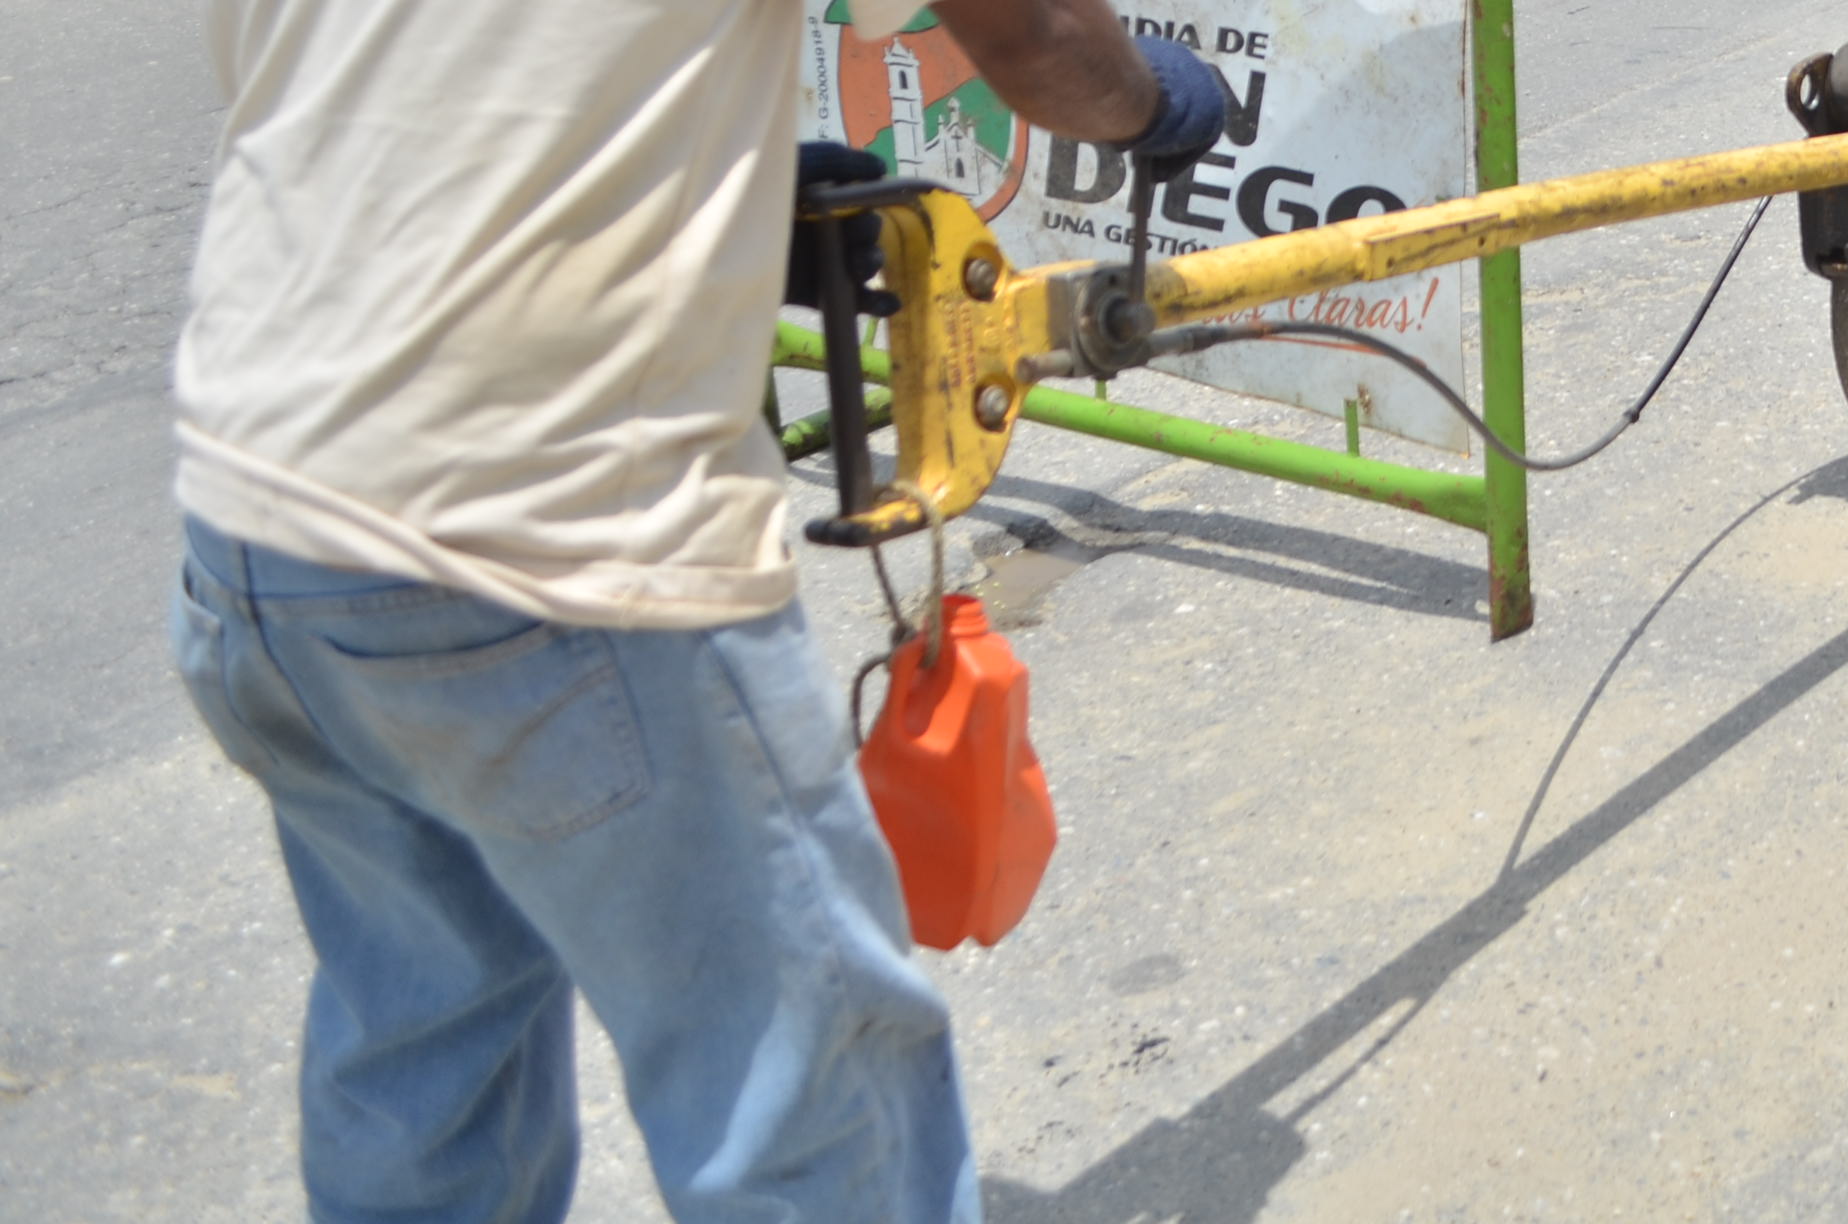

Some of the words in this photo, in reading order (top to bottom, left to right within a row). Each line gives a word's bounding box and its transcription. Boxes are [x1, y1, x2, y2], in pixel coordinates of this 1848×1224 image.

[1215, 26, 1269, 60] DE
[1041, 211, 1096, 239] UNA
[1104, 223, 1218, 257] GETIÓ
